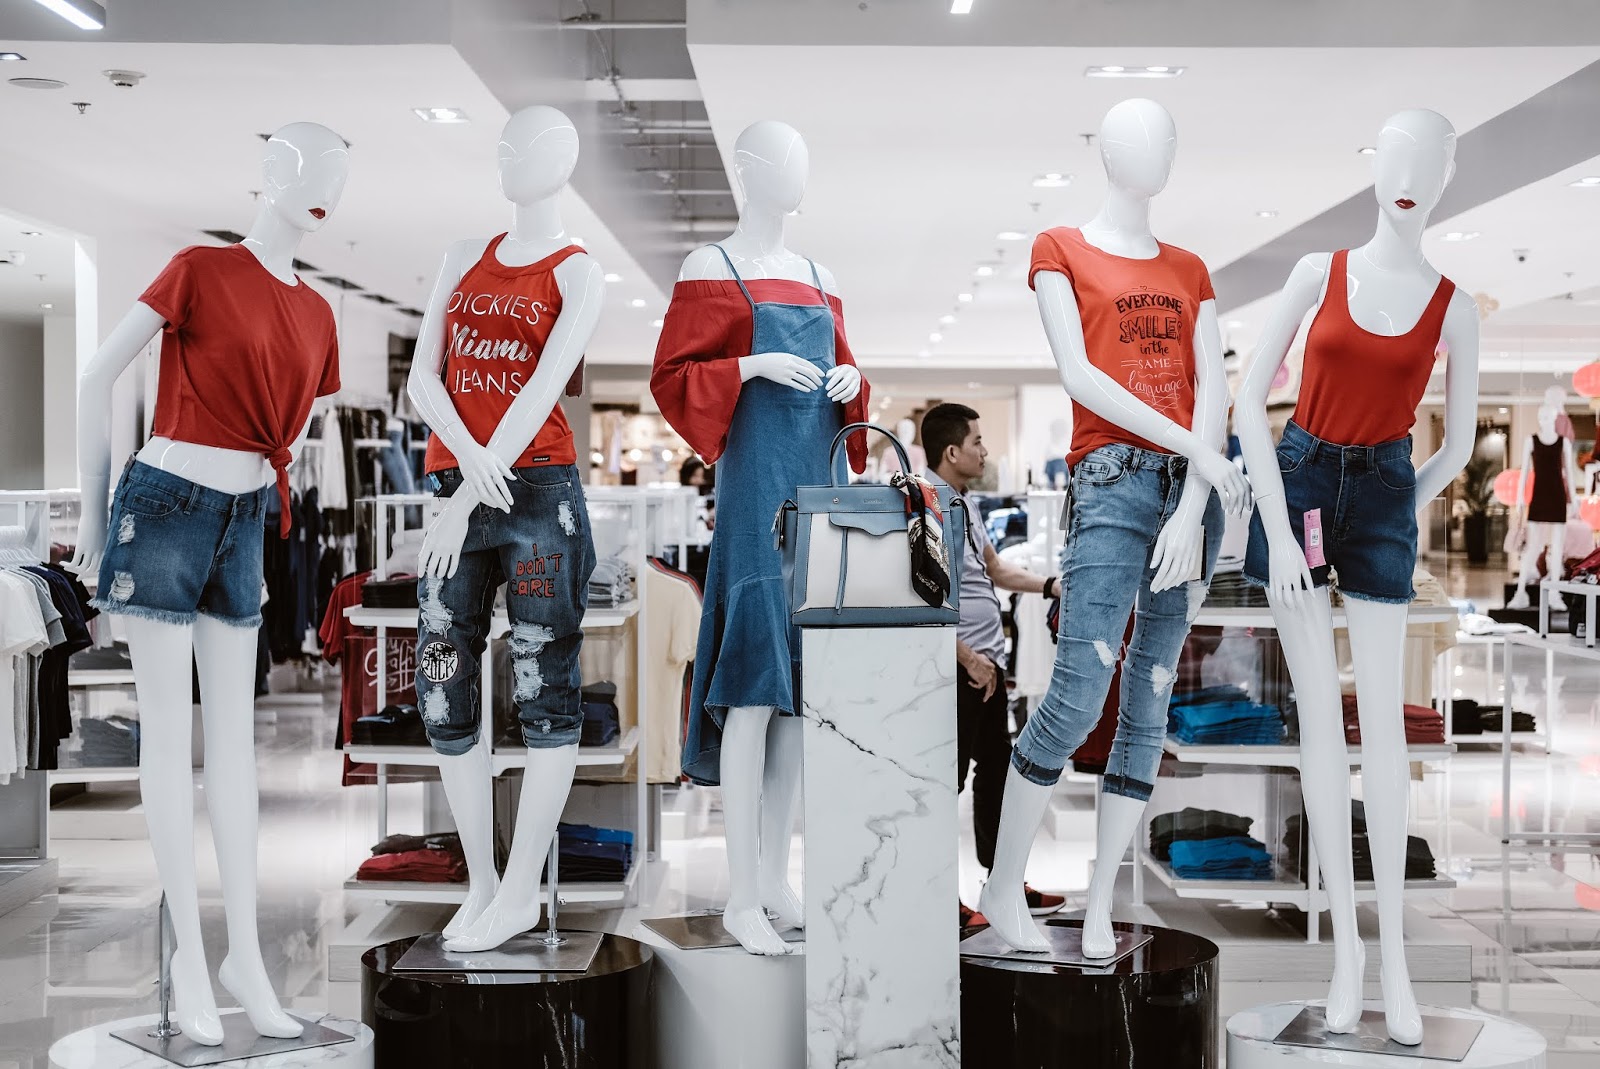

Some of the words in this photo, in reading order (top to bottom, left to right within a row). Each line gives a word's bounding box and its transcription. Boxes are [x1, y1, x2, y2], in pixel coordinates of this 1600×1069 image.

[1115, 294, 1183, 314] EVERYONE
[1119, 315, 1182, 345] SMILES
[1140, 343, 1151, 355] in
[1149, 341, 1169, 356] the
[1138, 358, 1171, 369] SAME
[452, 368, 523, 397] JEANS
[1127, 370, 1184, 404] language
[532, 543, 538, 556] I
